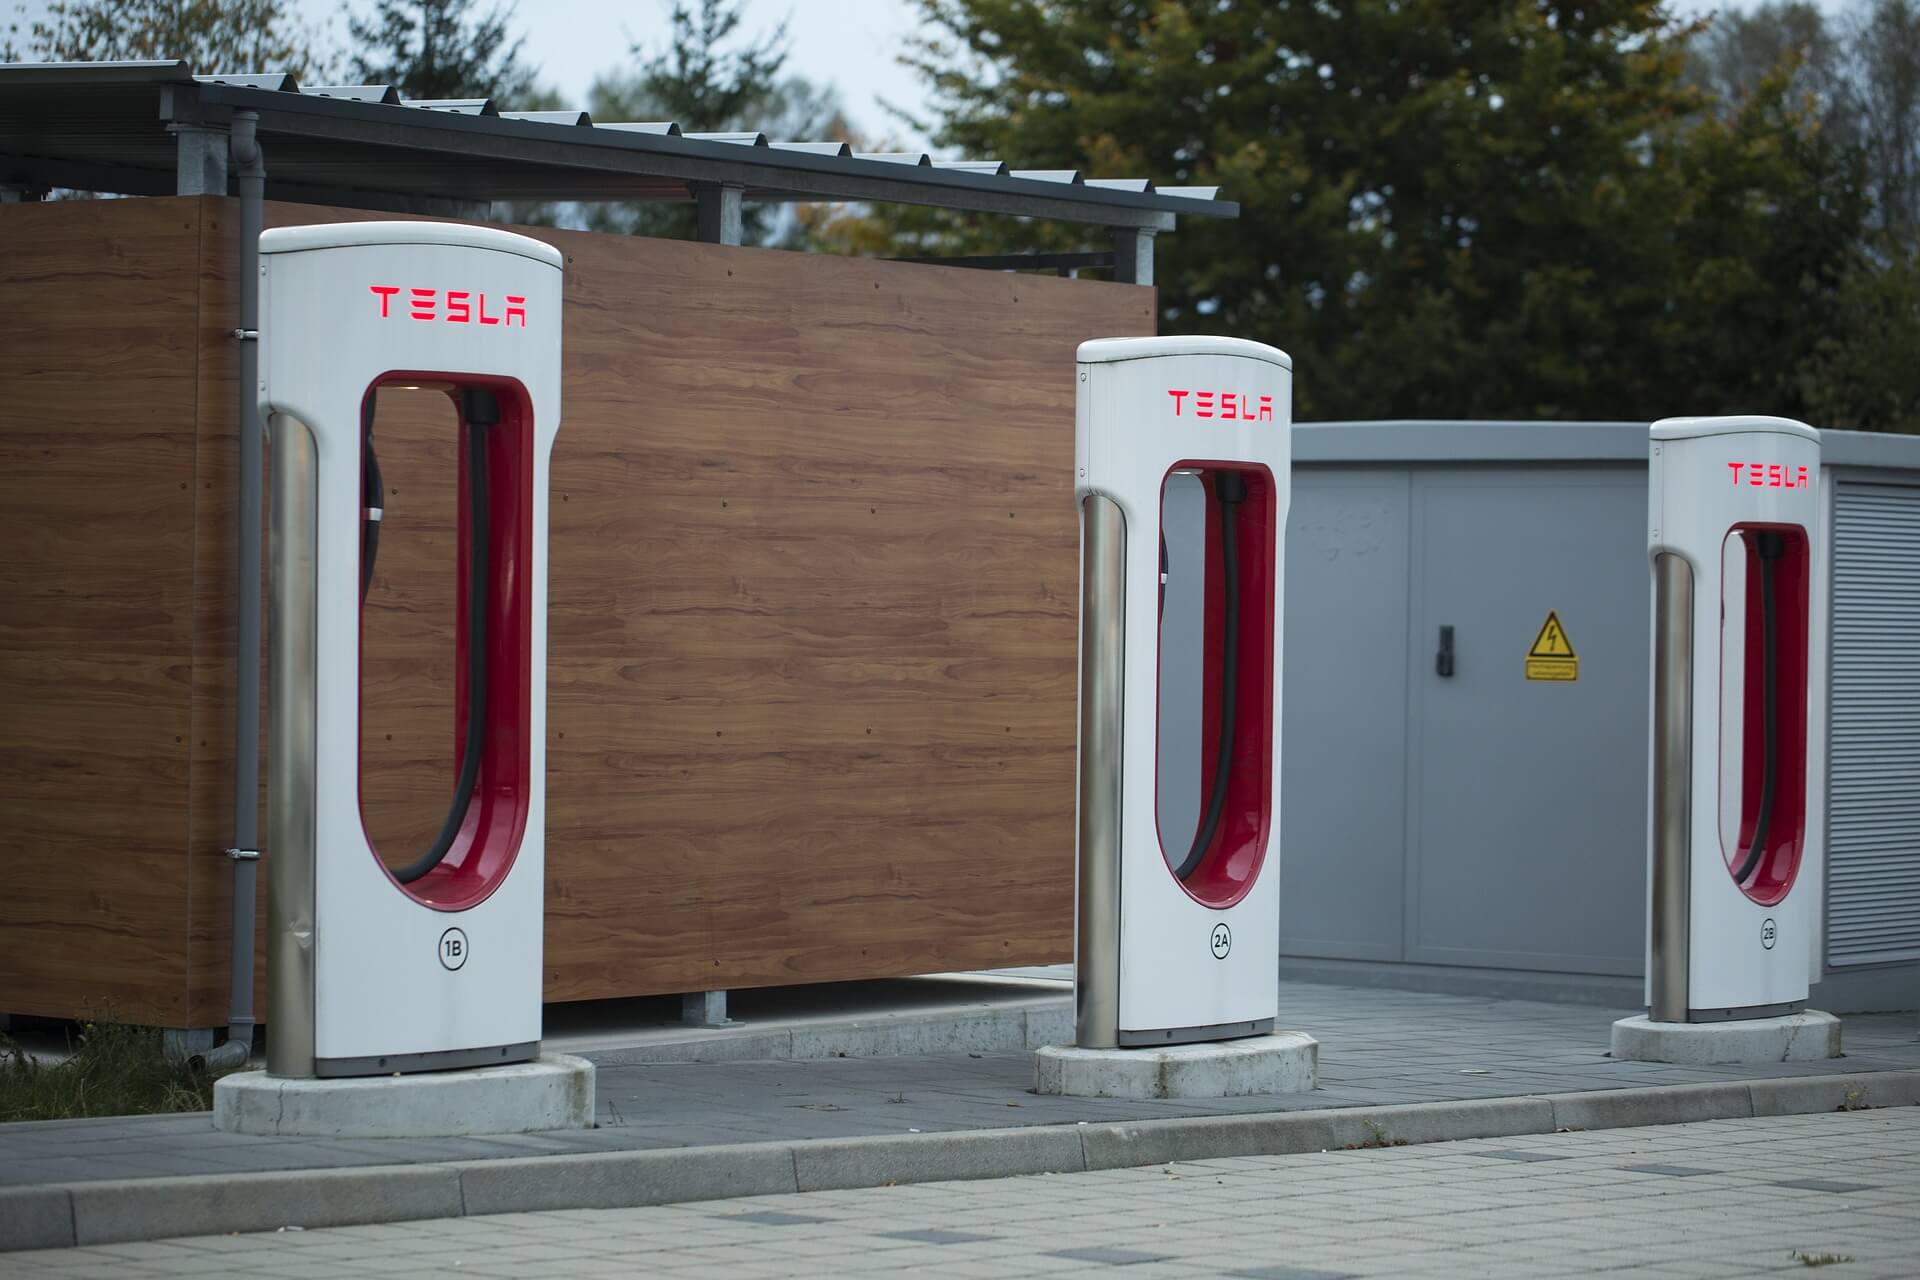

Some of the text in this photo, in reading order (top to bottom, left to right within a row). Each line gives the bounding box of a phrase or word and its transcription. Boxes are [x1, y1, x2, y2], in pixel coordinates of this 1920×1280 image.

[368, 286, 526, 328] TESLA
[1168, 390, 1272, 421] TESLA
[1728, 462, 1808, 488] TESLA
[1214, 933, 1229, 948] 2A
[1764, 928, 1774, 940] 2B
[445, 940, 462, 957] 1B
